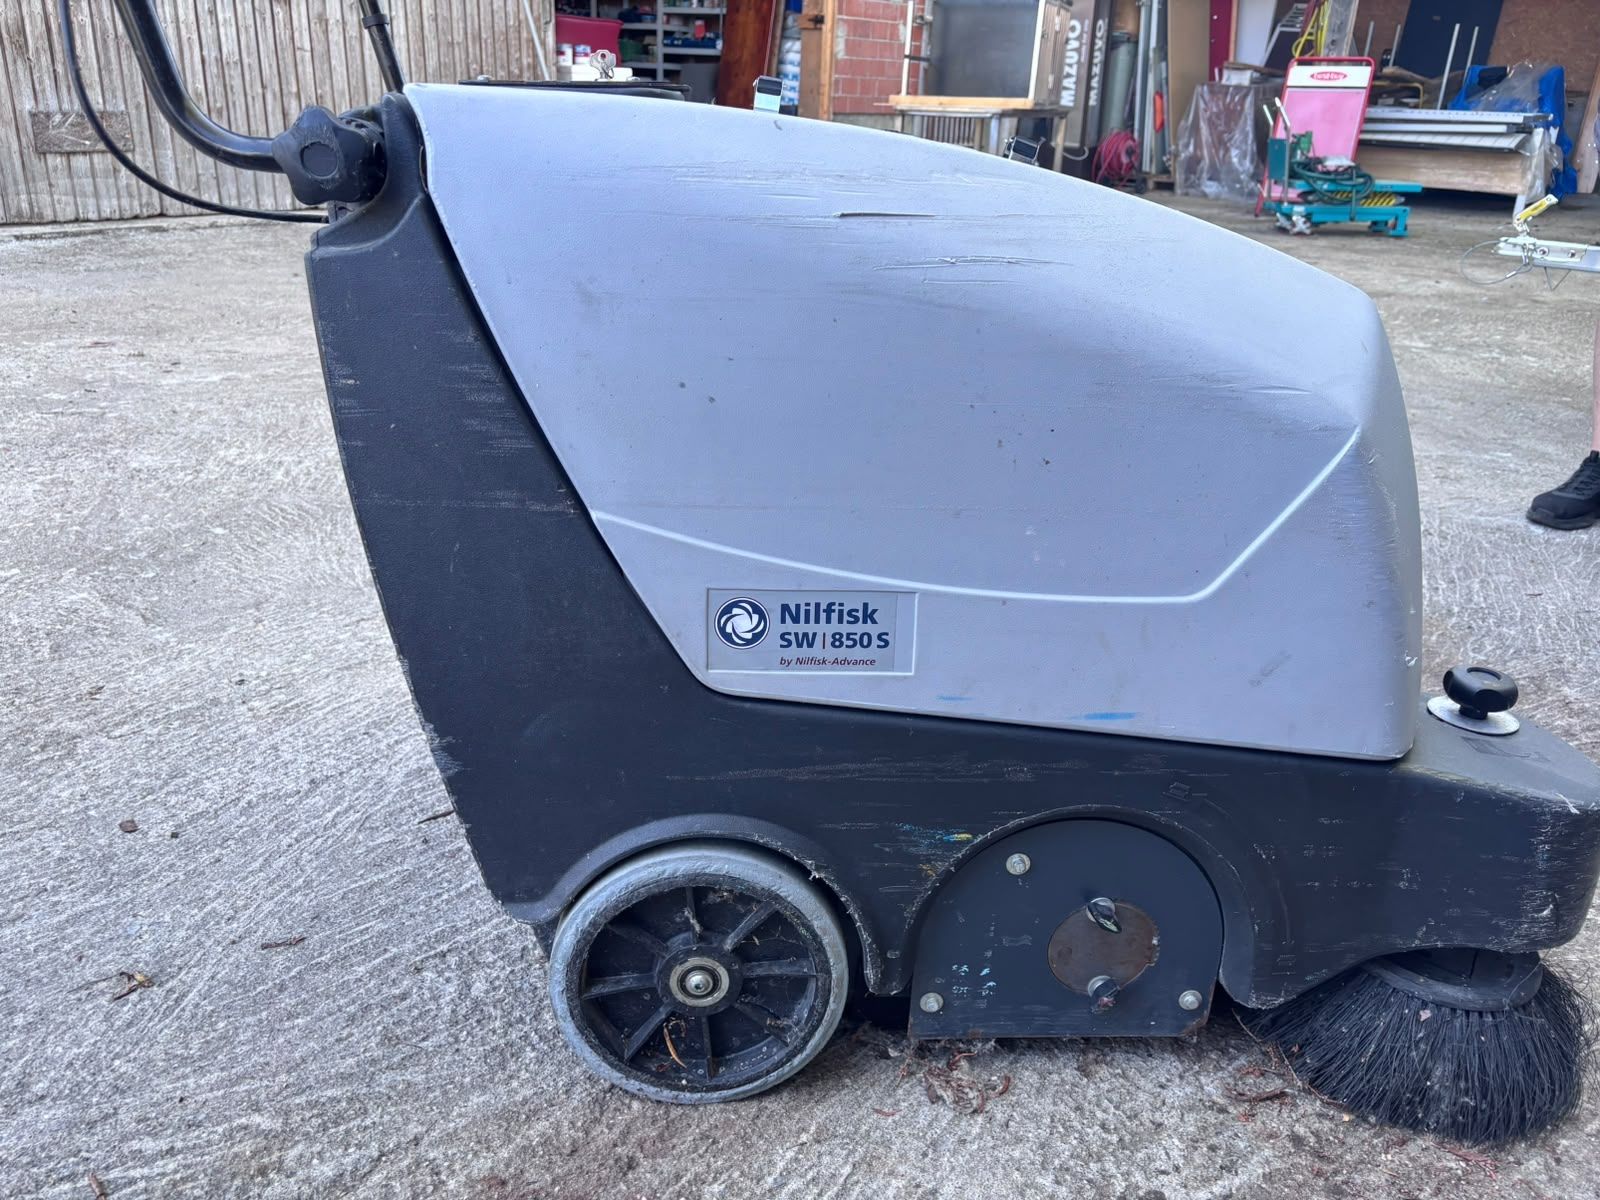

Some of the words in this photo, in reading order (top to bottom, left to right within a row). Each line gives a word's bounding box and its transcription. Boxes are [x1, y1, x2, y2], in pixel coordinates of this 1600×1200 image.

[1060, 19, 1081, 107] MAZUVO
[1088, 19, 1104, 106] MAZUVO
[780, 602, 879, 625] Nilfisk
[779, 632, 818, 649] SW
[830, 632, 873, 649] 850
[876, 632, 890, 649] S
[779, 657, 793, 667] by
[795, 656, 876, 666] Nilfisk-Advance
